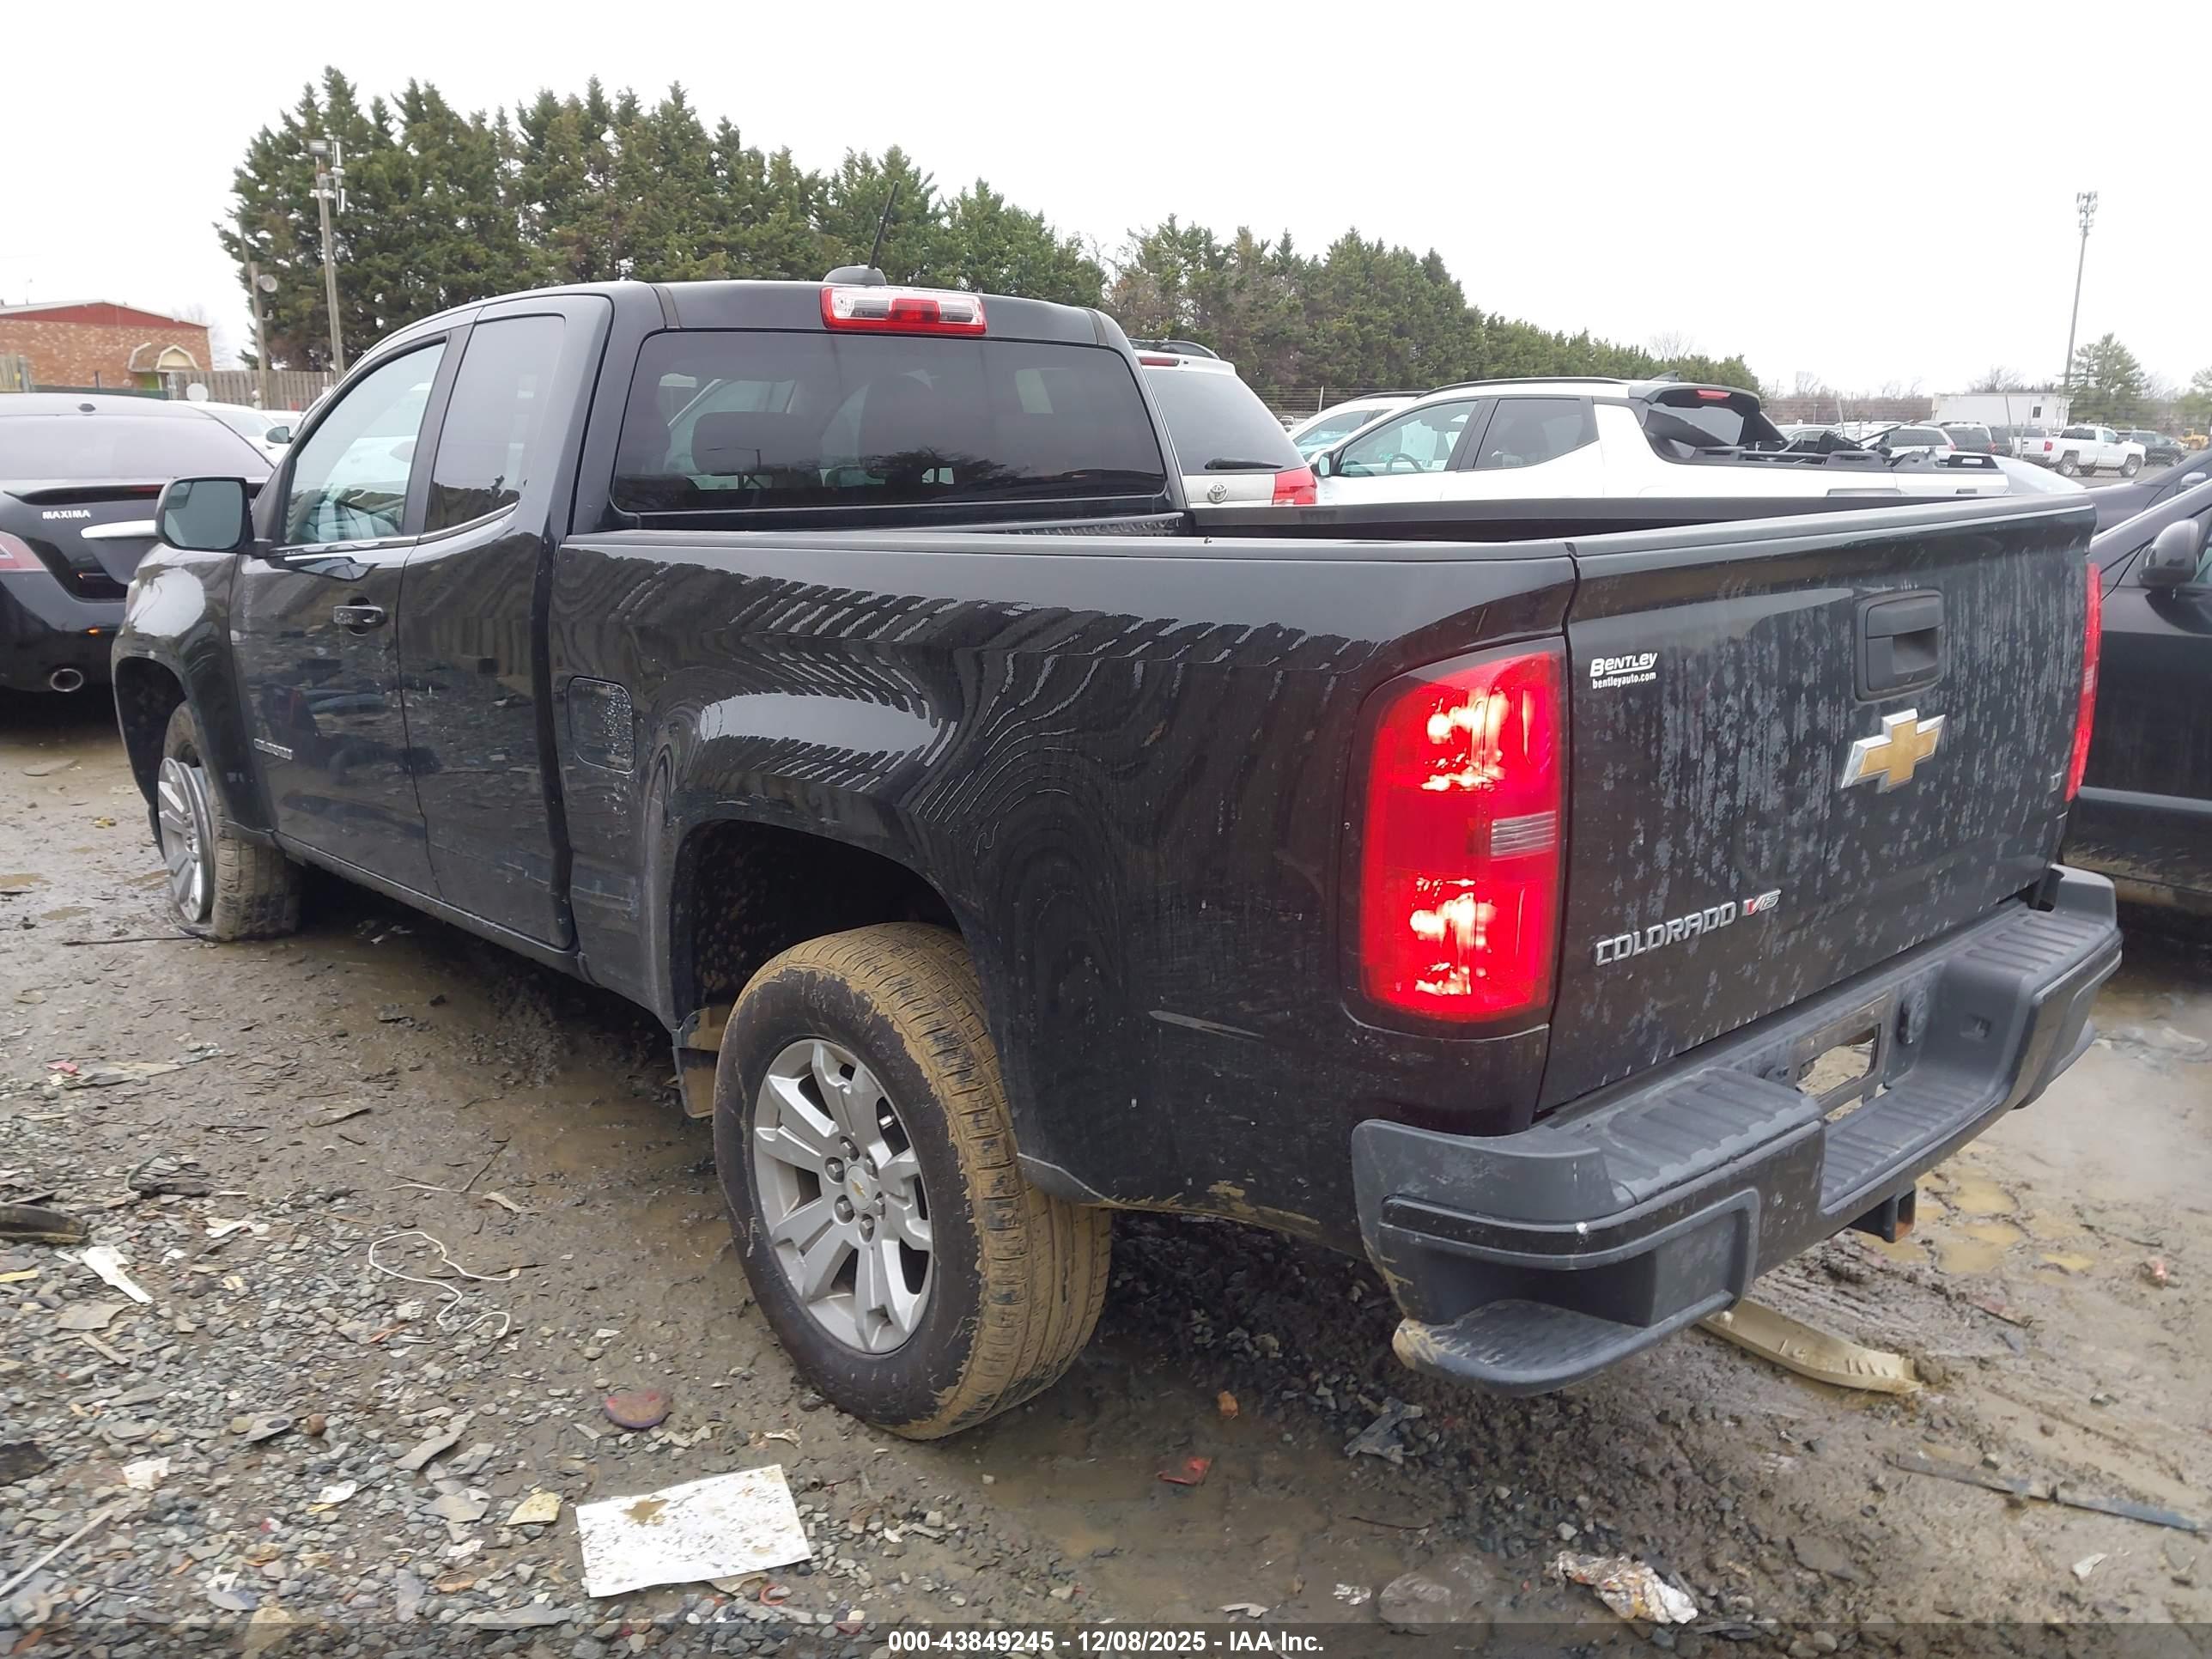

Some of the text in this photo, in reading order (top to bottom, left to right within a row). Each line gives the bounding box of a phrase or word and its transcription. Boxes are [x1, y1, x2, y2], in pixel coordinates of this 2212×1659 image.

[42, 509, 91, 520] MAXIMA
[1592, 672, 1656, 690] bentleyauto.com
[1596, 888, 1782, 967] COLORADO V6
